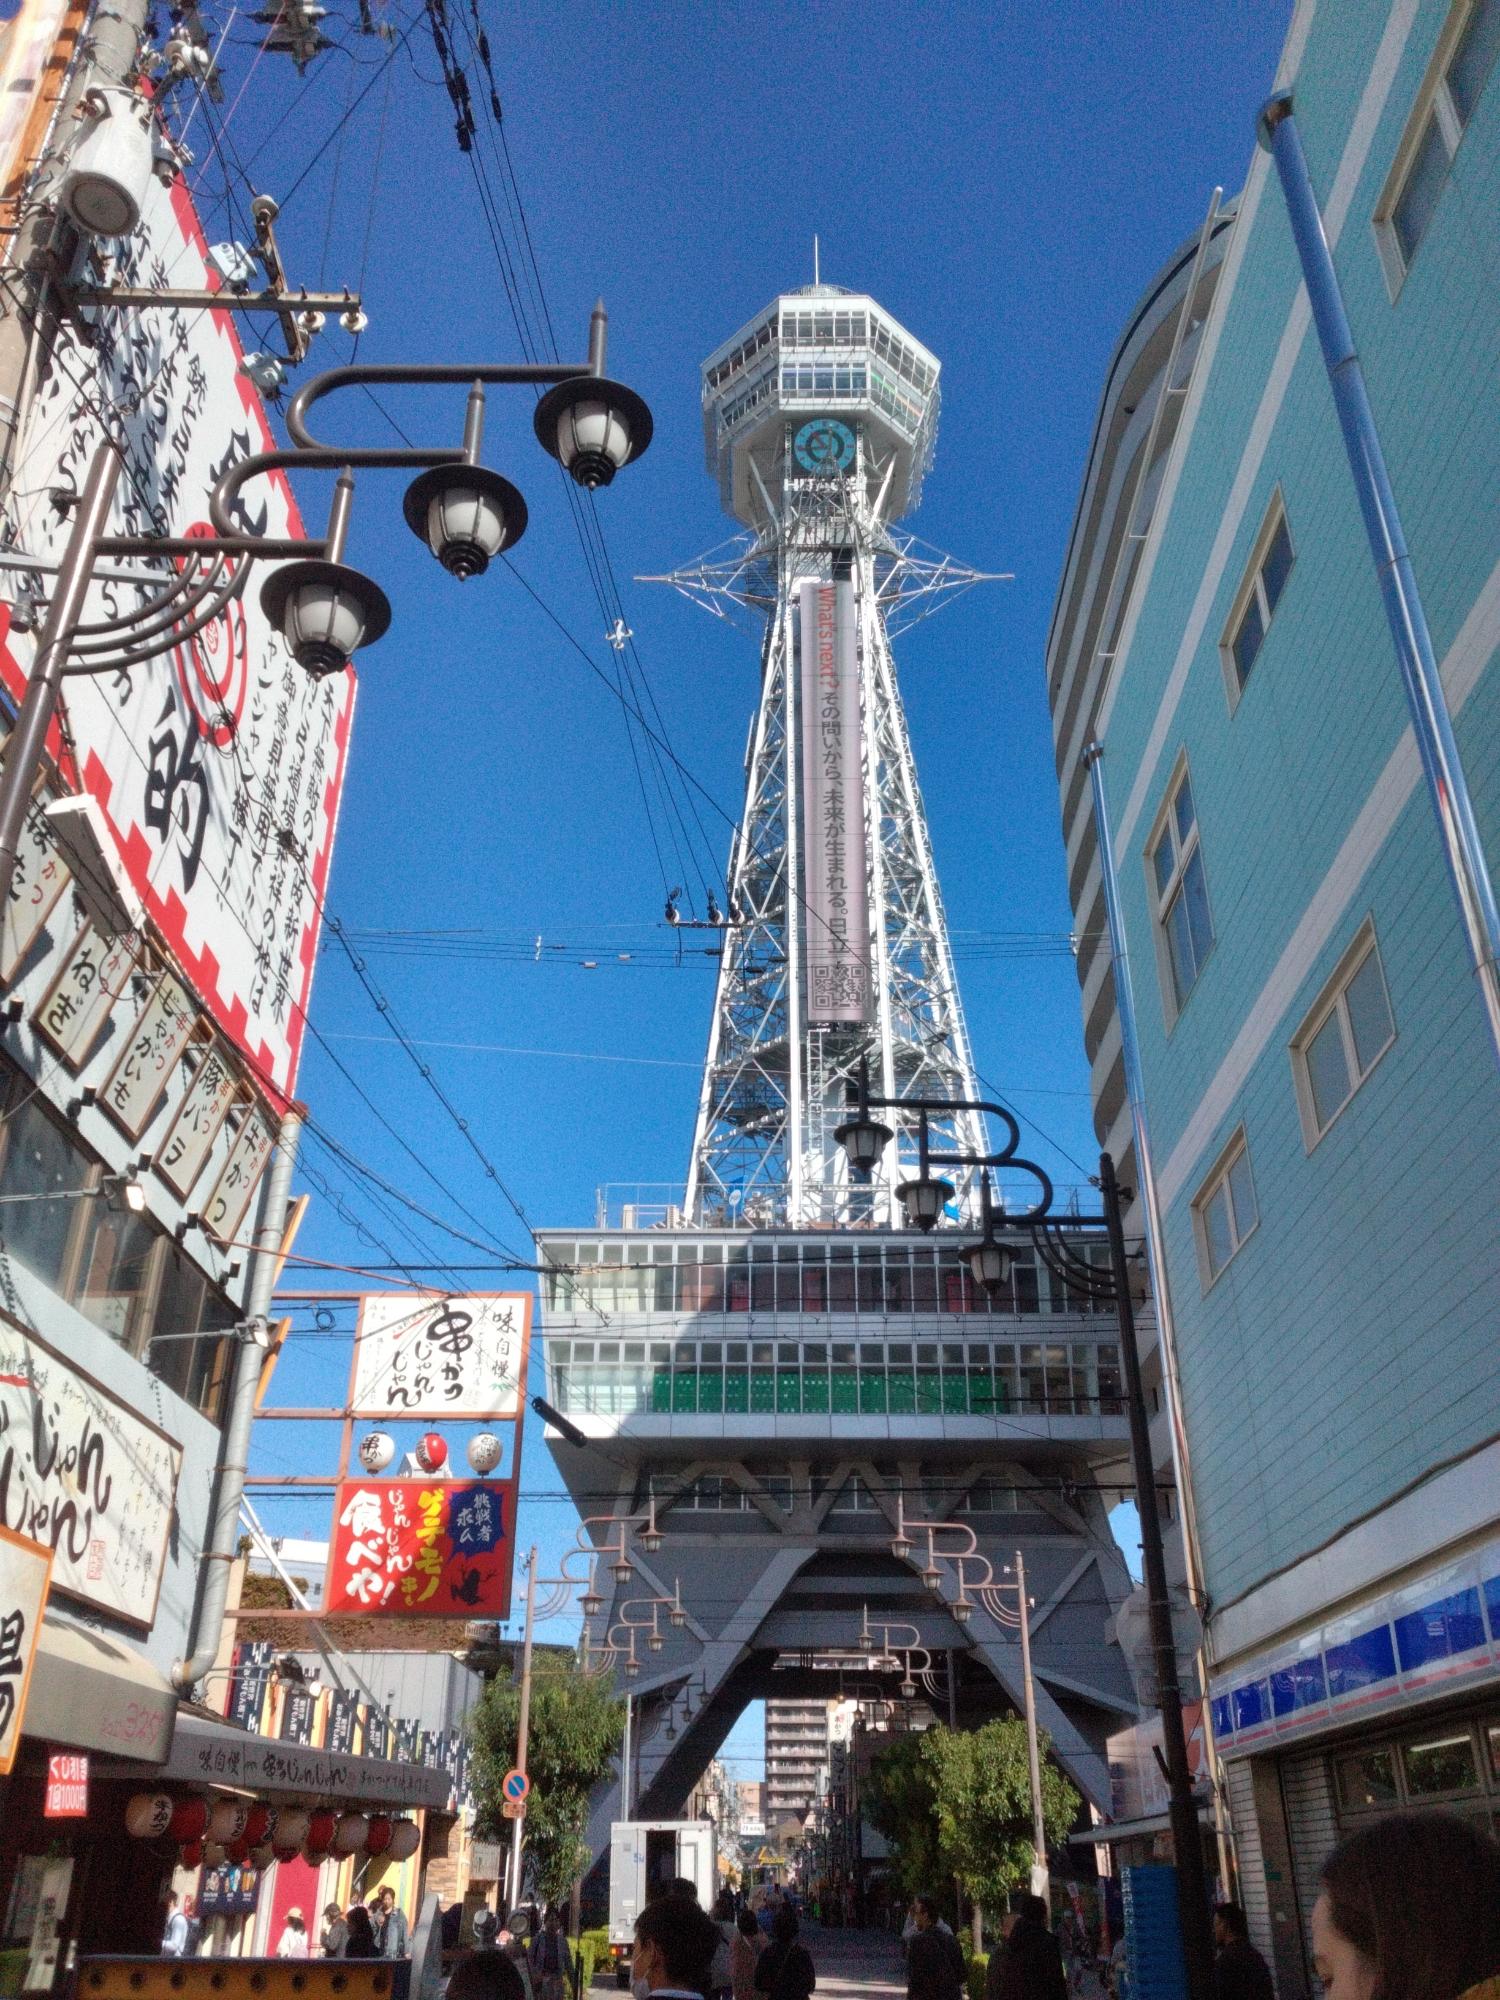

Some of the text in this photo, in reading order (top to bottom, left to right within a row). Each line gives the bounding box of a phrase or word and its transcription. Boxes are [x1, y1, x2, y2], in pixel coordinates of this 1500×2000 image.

[817, 586, 837, 640] What's
[818, 642, 840, 689] next?
[111, 985, 178, 1113] じゃがいも
[164, 1050, 229, 1169] 豚バラ
[214, 1112, 263, 1222] 牛かつ
[414, 1340, 435, 1394] じゃん
[427, 1303, 474, 1401] 串かつ
[492, 1305, 518, 1380] 味自慢
[387, 1350, 422, 1407] じゃん
[362, 1435, 382, 1464] 串かつ
[339, 1489, 395, 1605] 食べや!
[386, 1489, 413, 1573] じゃんじゃん
[415, 1488, 445, 1602] ゲテモノ
[456, 1508, 474, 1543] 求ム
[473, 1493, 493, 1543] 挑戦者
[198, 1749, 241, 1776] 味自慢
